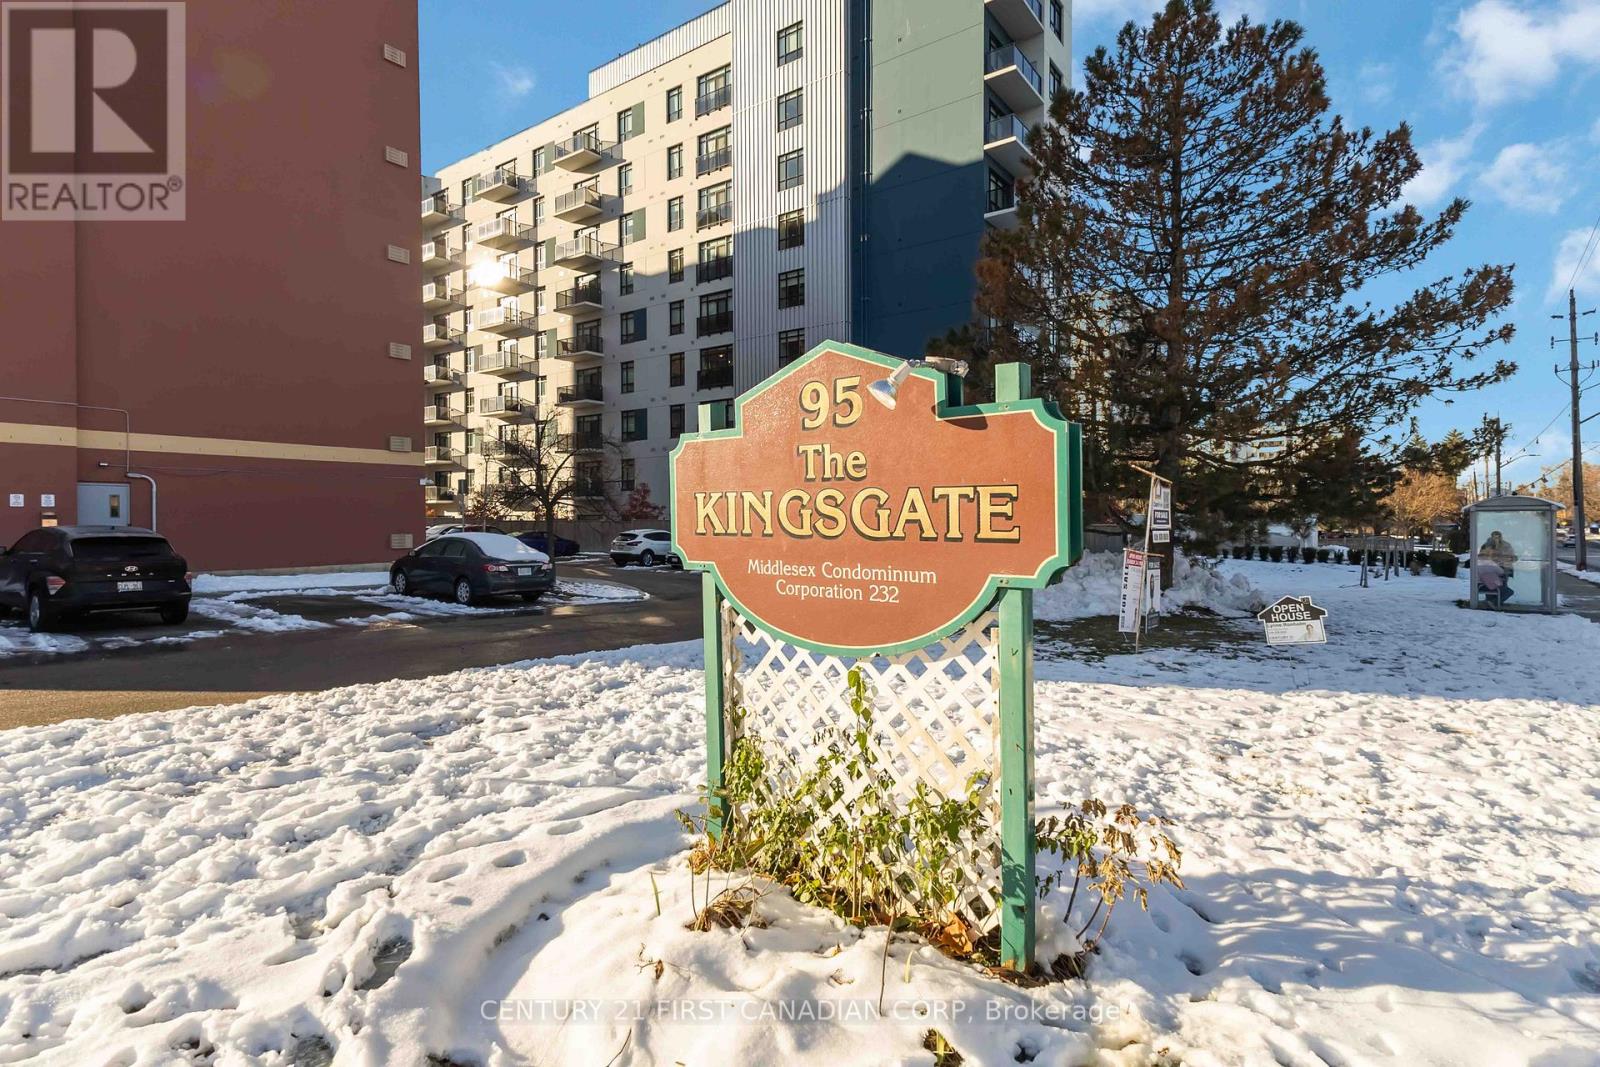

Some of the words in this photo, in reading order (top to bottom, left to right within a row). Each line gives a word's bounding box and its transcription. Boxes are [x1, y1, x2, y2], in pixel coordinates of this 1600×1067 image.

[799, 376, 863, 430] 95
[797, 443, 867, 482] The
[694, 484, 1021, 543] KINGSGATE
[747, 559, 816, 578] Middlesex
[821, 562, 937, 584] Condominium
[775, 579, 863, 601] Corporation
[869, 584, 900, 603] 232
[1271, 611, 1312, 622] HOUSE
[1272, 603, 1305, 614] OPEN
